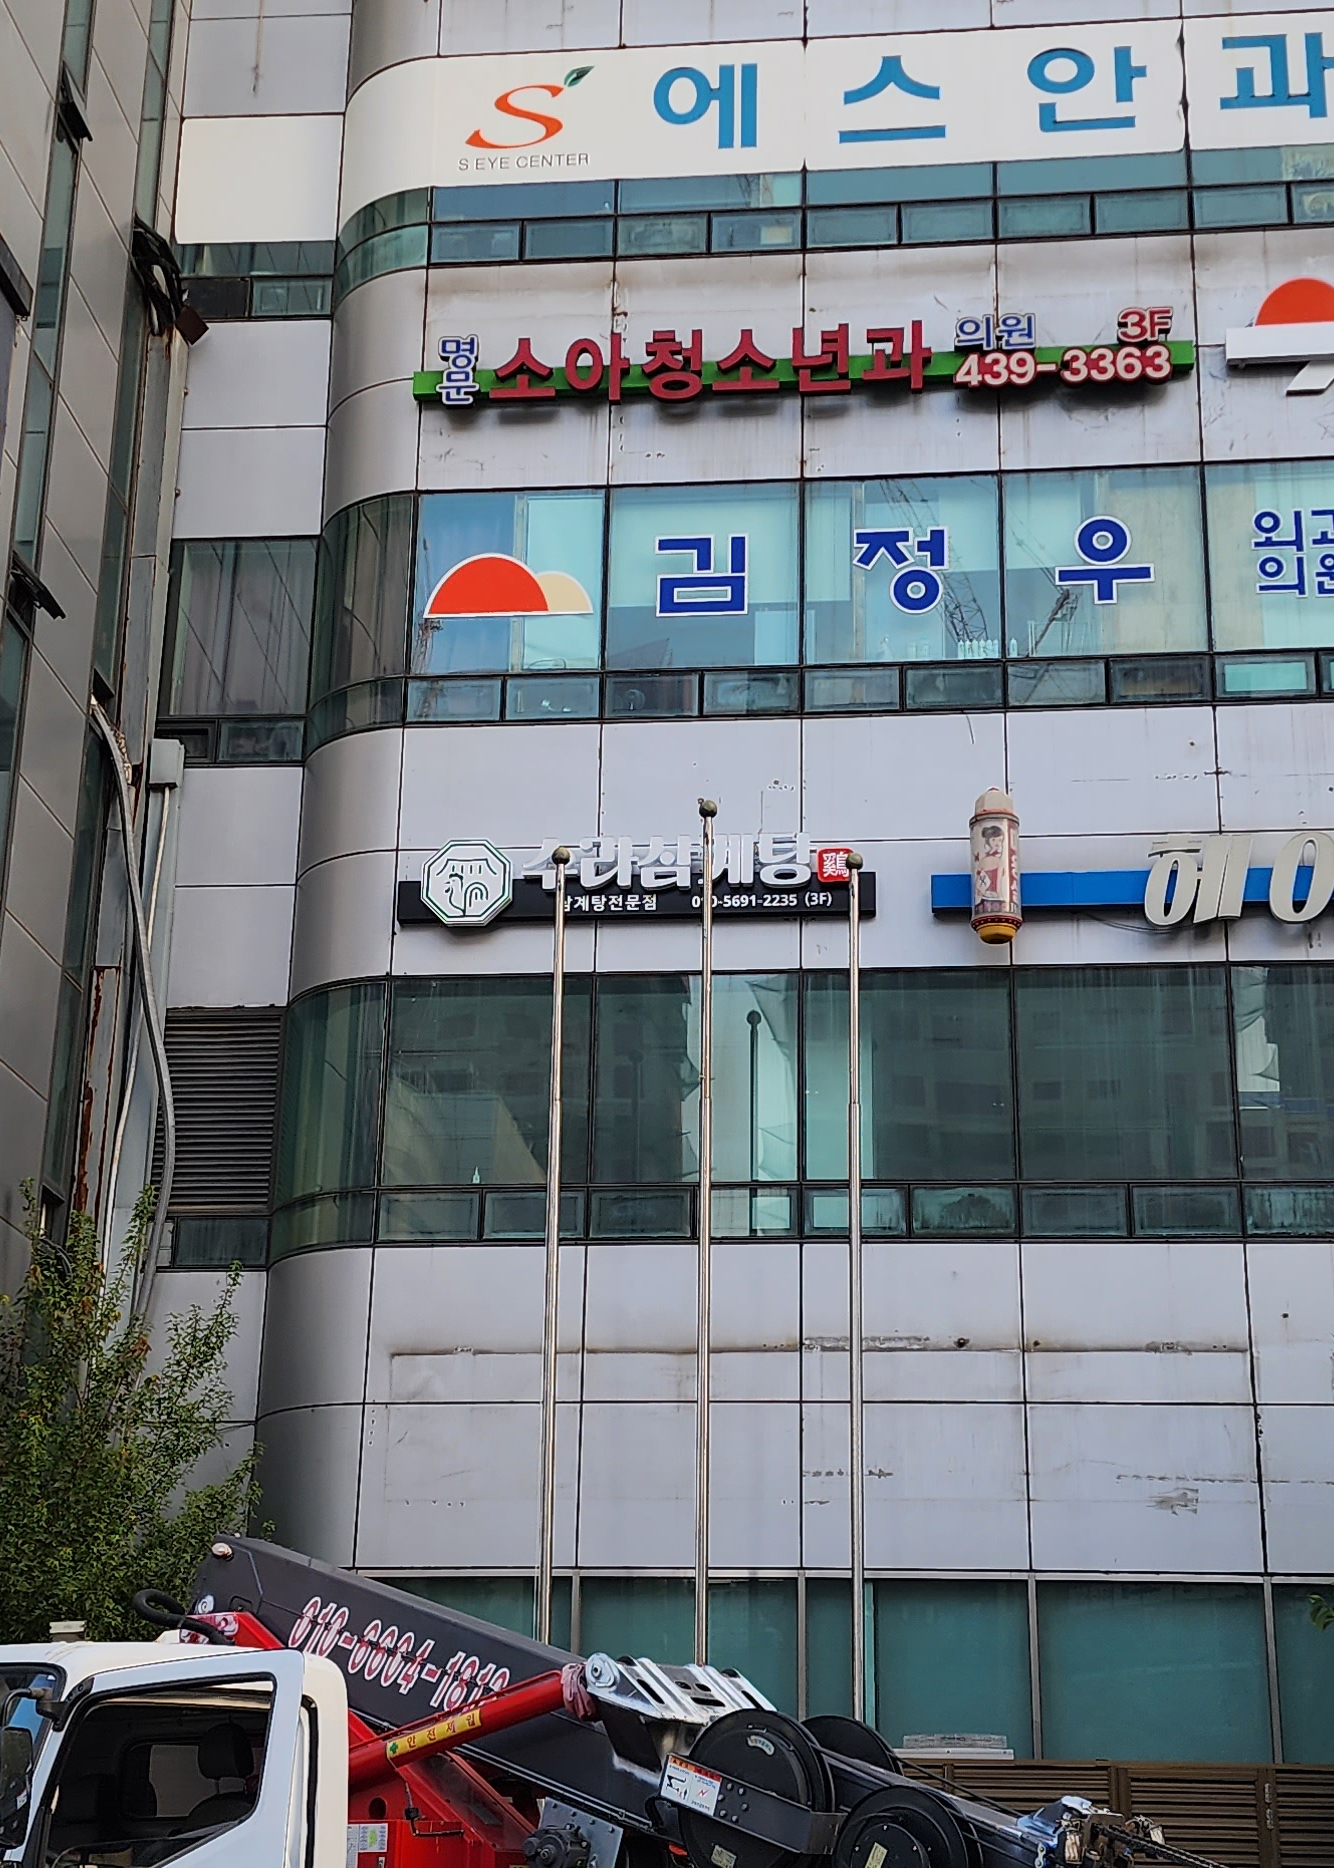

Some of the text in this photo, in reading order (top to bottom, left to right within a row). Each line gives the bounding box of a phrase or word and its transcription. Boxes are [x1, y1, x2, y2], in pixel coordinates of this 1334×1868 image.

[474, 156, 510, 171] EYE
[516, 152, 589, 168] CENTER
[437, 334, 480, 404] 명문
[489, 306, 1173, 400] 소아청소년과 의원 3F
[953, 343, 1173, 387] 439-3363
[655, 515, 1156, 617] 김정우
[691, 891, 832, 909] 00-5691-2235 (3F)
